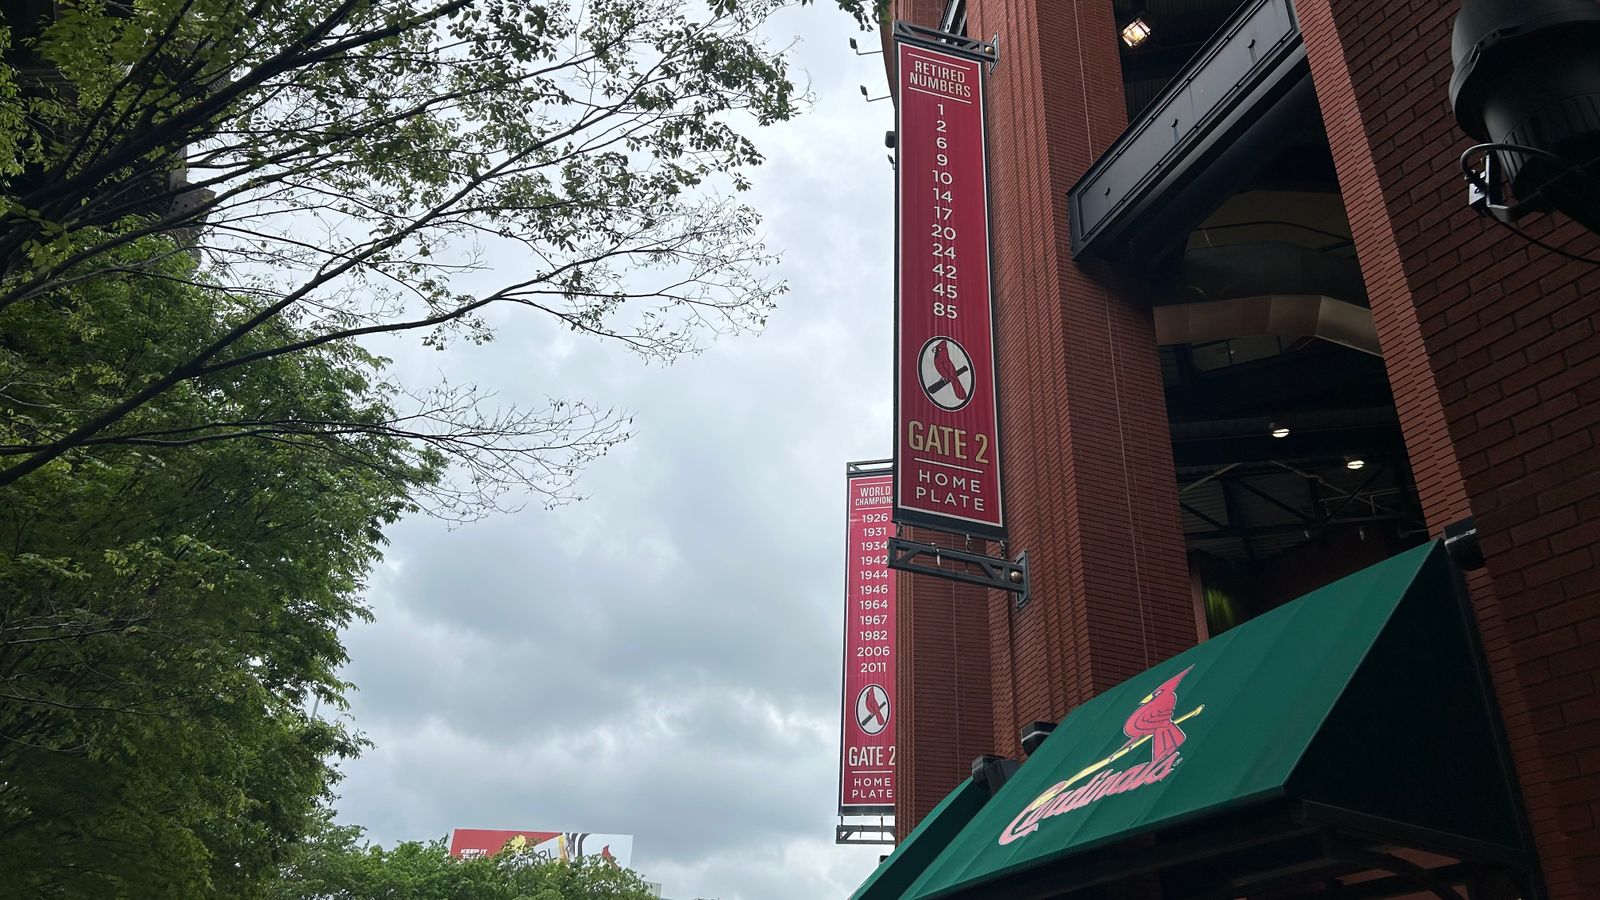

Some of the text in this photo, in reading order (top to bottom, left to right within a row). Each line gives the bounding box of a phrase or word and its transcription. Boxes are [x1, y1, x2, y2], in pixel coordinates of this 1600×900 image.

[915, 60, 965, 83] RETIRED
[910, 72, 971, 98] NUMBERS
[938, 104, 944, 116] 1
[936, 120, 946, 132] 2
[936, 137, 947, 149] 6
[937, 154, 948, 166] 9
[932, 170, 952, 185] 10
[933, 188, 952, 203] 14
[934, 206, 952, 220] 17
[931, 224, 956, 240] 20
[932, 243, 956, 259] 24
[932, 264, 957, 279] 42
[932, 283, 957, 299] 45
[933, 302, 957, 319] 85
[908, 420, 989, 464] GATE 2
[919, 469, 981, 493] HOME
[860, 486, 890, 497] WORLD
[916, 486, 984, 511] PLATE
[862, 513, 888, 523] 1926
[863, 527, 886, 536] 1931
[861, 541, 888, 551] 1934
[861, 556, 888, 565] 1942
[860, 570, 888, 580] 1944
[860, 584, 888, 595] 1946
[860, 600, 888, 610] 1964
[860, 615, 888, 625] 1967
[860, 630, 888, 640] 1982
[857, 646, 890, 656] 2006
[861, 662, 886, 672] 2011
[849, 746, 895, 766] GATE 2
[854, 778, 891, 786] HOME
[852, 790, 892, 798] PLATE
[999, 752, 1180, 845] Cardinals
